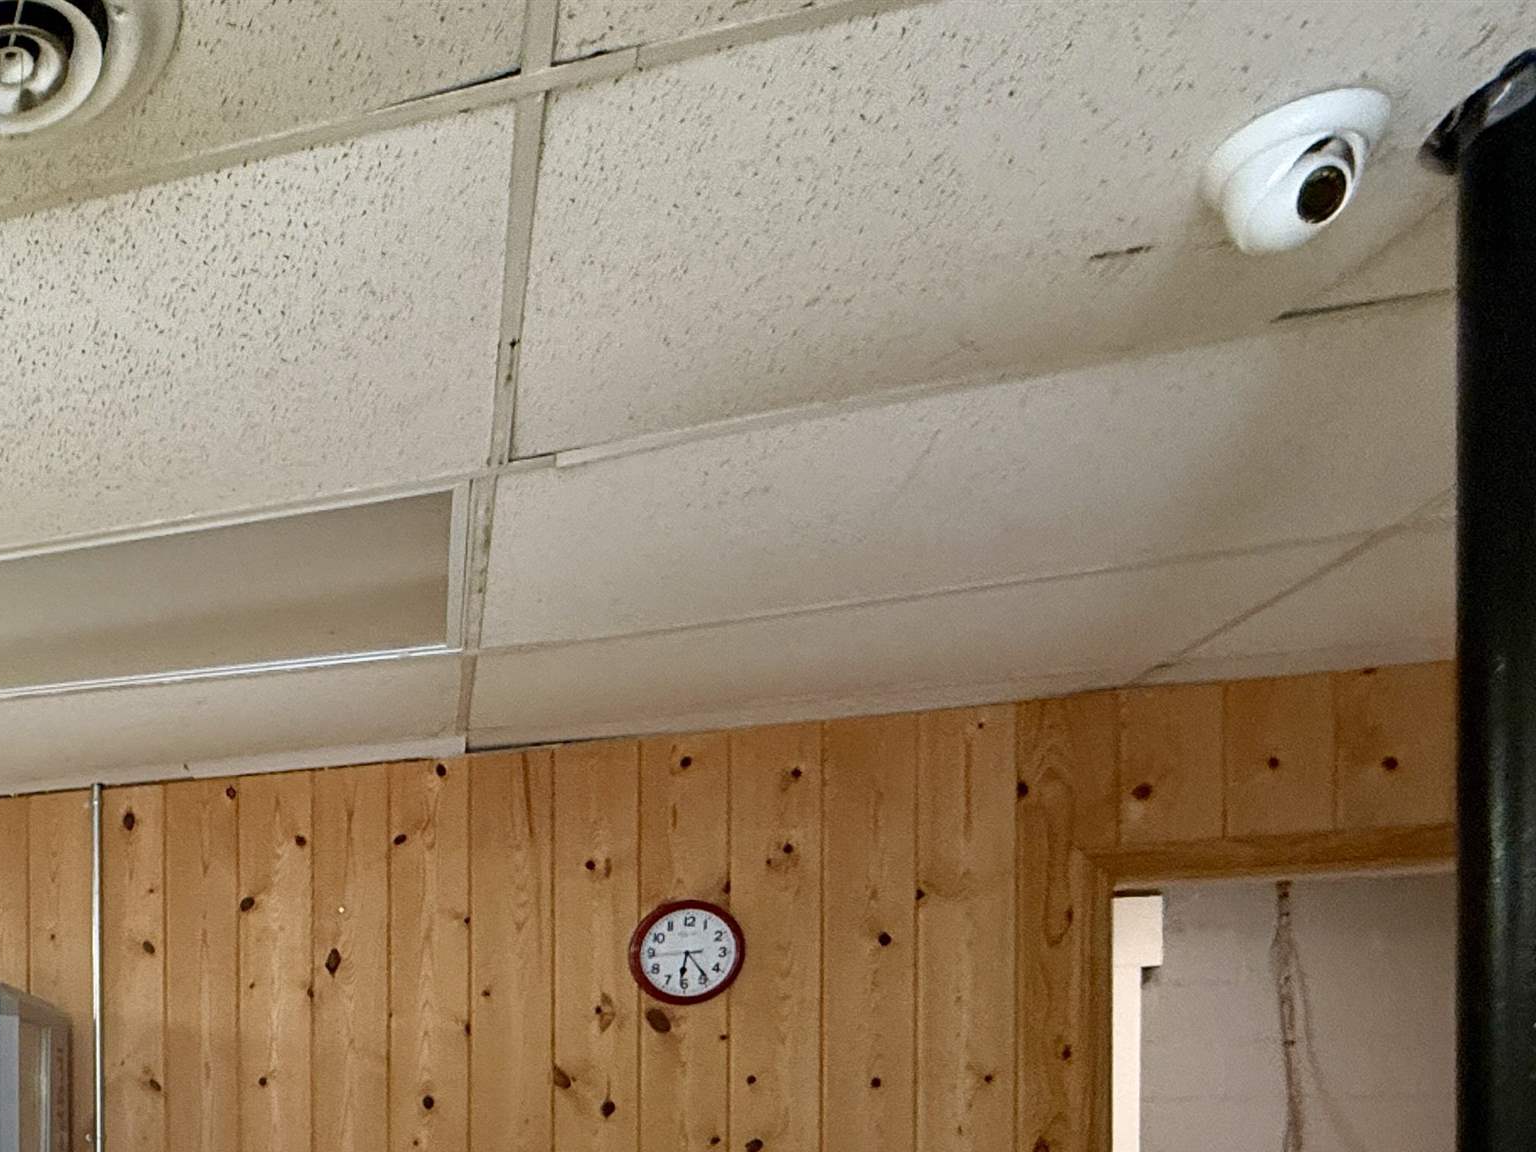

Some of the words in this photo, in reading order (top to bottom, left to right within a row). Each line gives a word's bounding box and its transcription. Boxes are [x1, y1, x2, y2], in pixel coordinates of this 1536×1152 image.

[667, 921, 674, 931] 11
[684, 916, 696, 927] 12
[703, 919, 708, 930] 1
[653, 932, 665, 944] 10
[713, 930, 723, 942] 2
[647, 947, 656, 958] 9
[718, 947, 727, 958] 3
[651, 963, 660, 974] 8
[712, 962, 720, 973] 4
[664, 975, 672, 985] 7
[679, 977, 689, 989] 6
